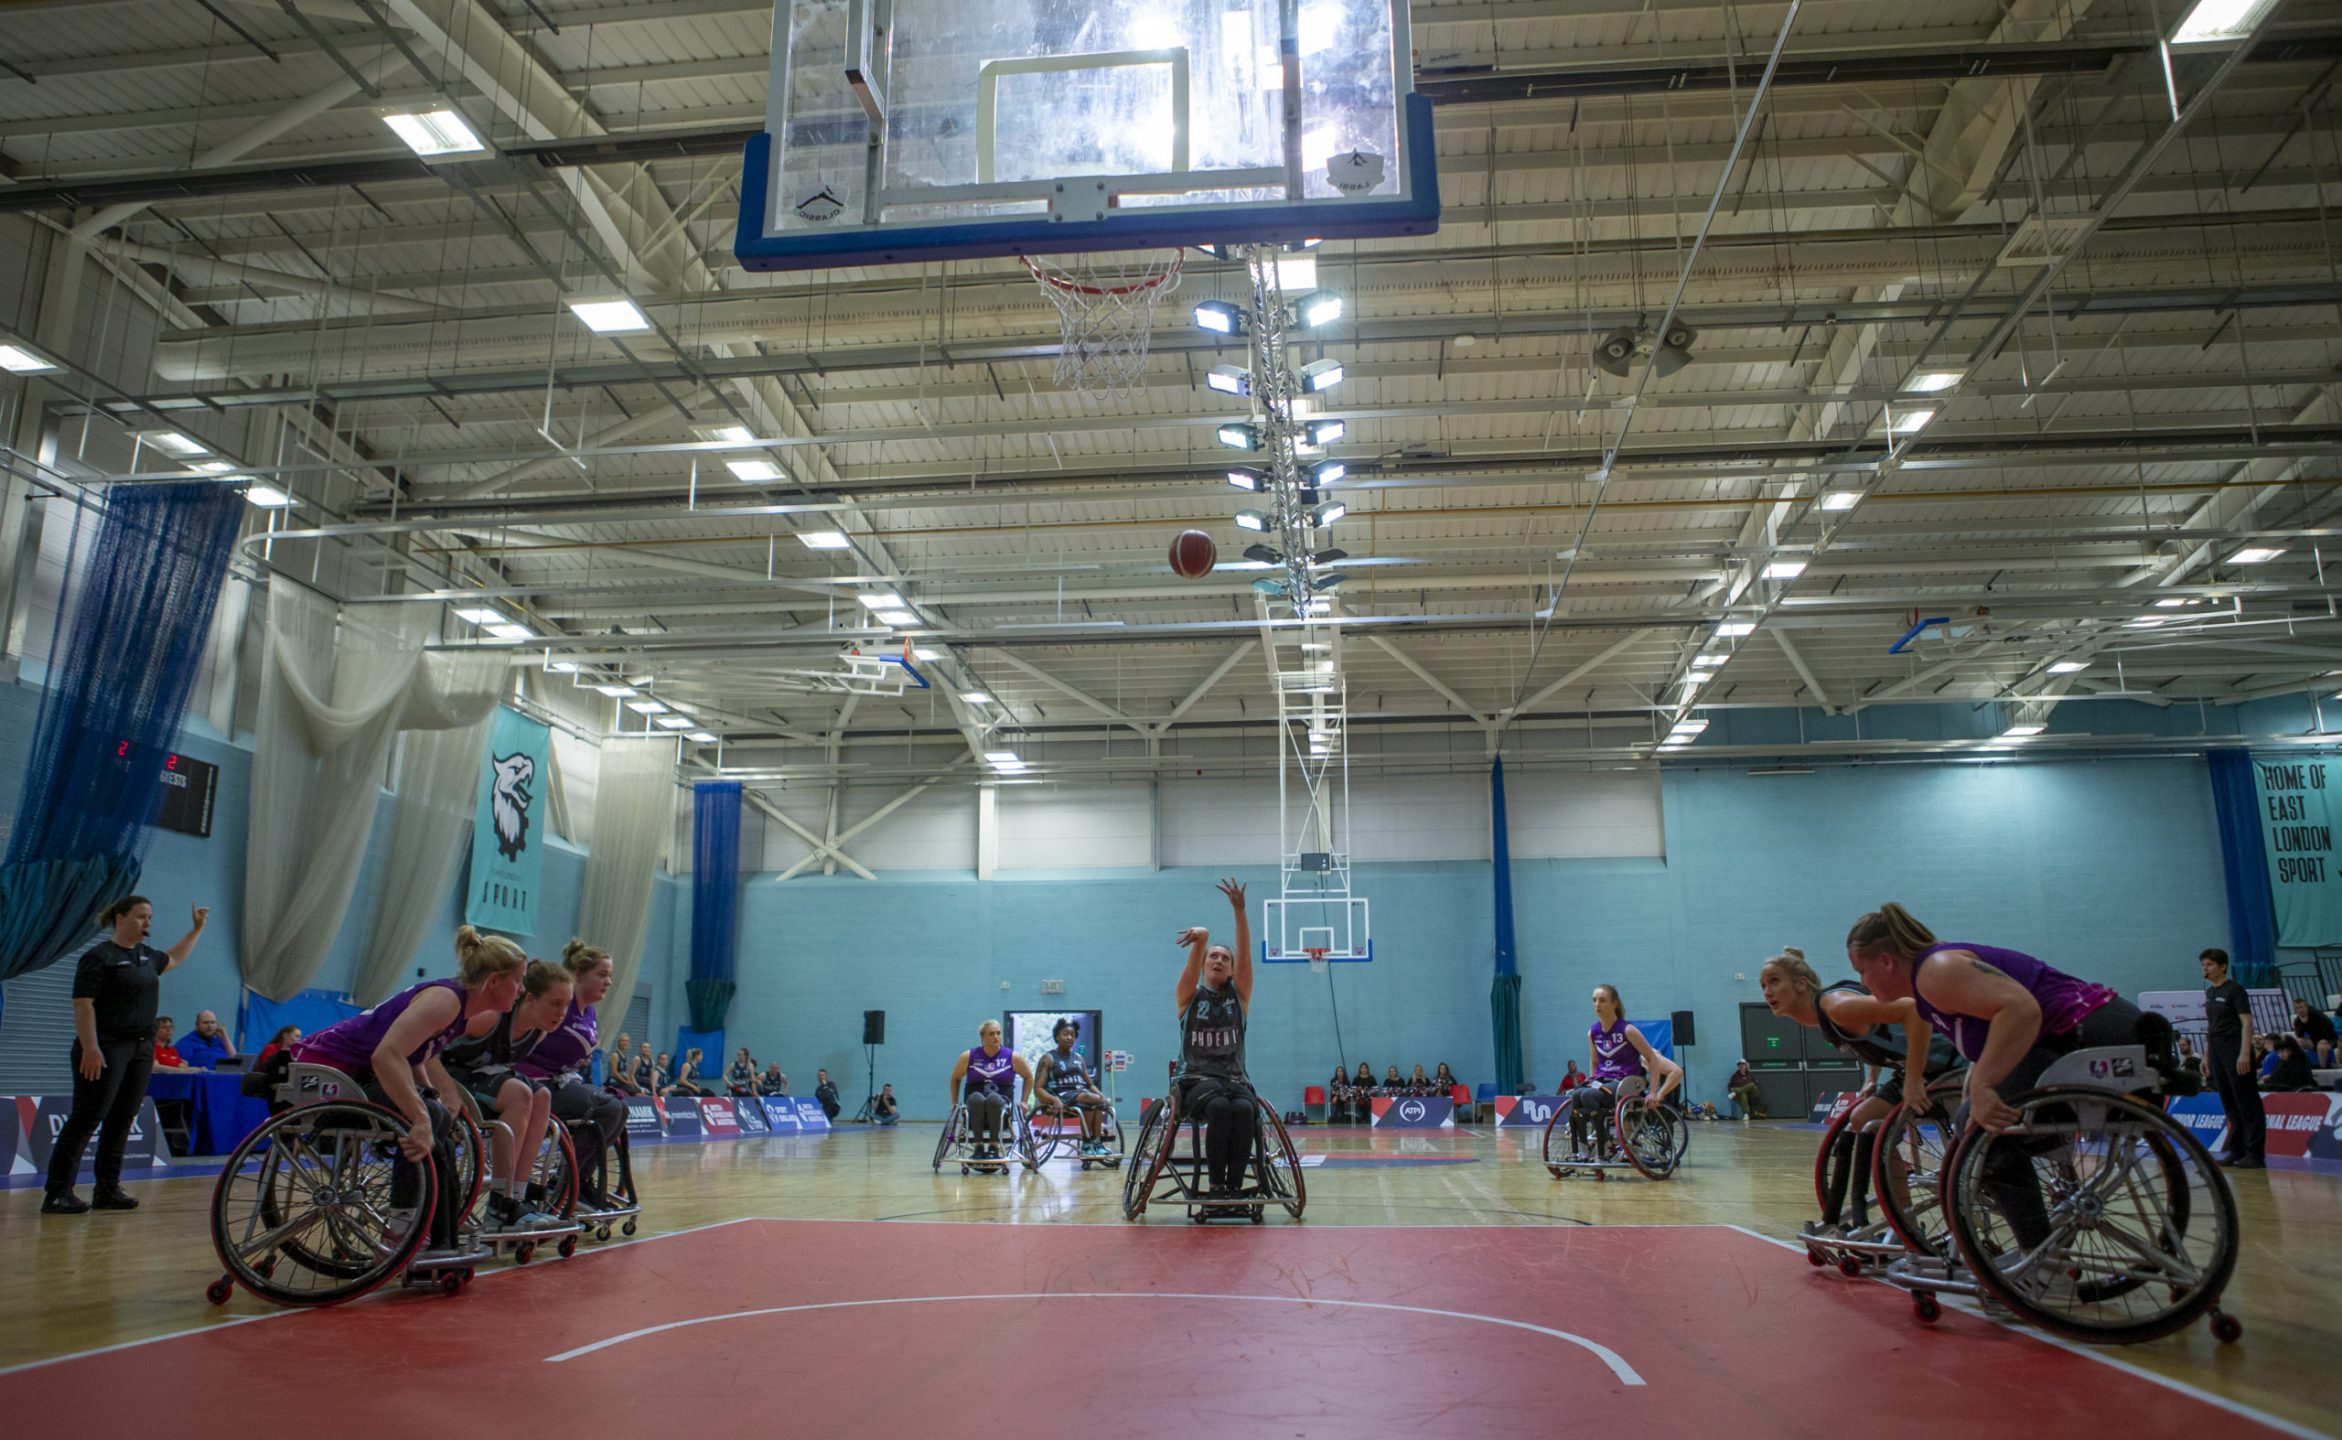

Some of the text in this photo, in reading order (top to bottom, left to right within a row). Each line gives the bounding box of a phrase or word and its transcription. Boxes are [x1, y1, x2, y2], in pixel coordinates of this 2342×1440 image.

[118, 741, 129, 756] 2
[166, 754, 177, 770] 2
[2263, 764, 2326, 790] HOME OF
[2267, 795, 2306, 821] EAST
[2271, 826, 2332, 852] LONDON
[2278, 857, 2326, 883] SPORT
[482, 881, 527, 912] SPORT
[1611, 1032, 1624, 1044] 13
[996, 1058, 1007, 1068] 17
[2195, 1114, 2225, 1129] LEAGUE
[2286, 1115, 2323, 1131] LEAGUE
